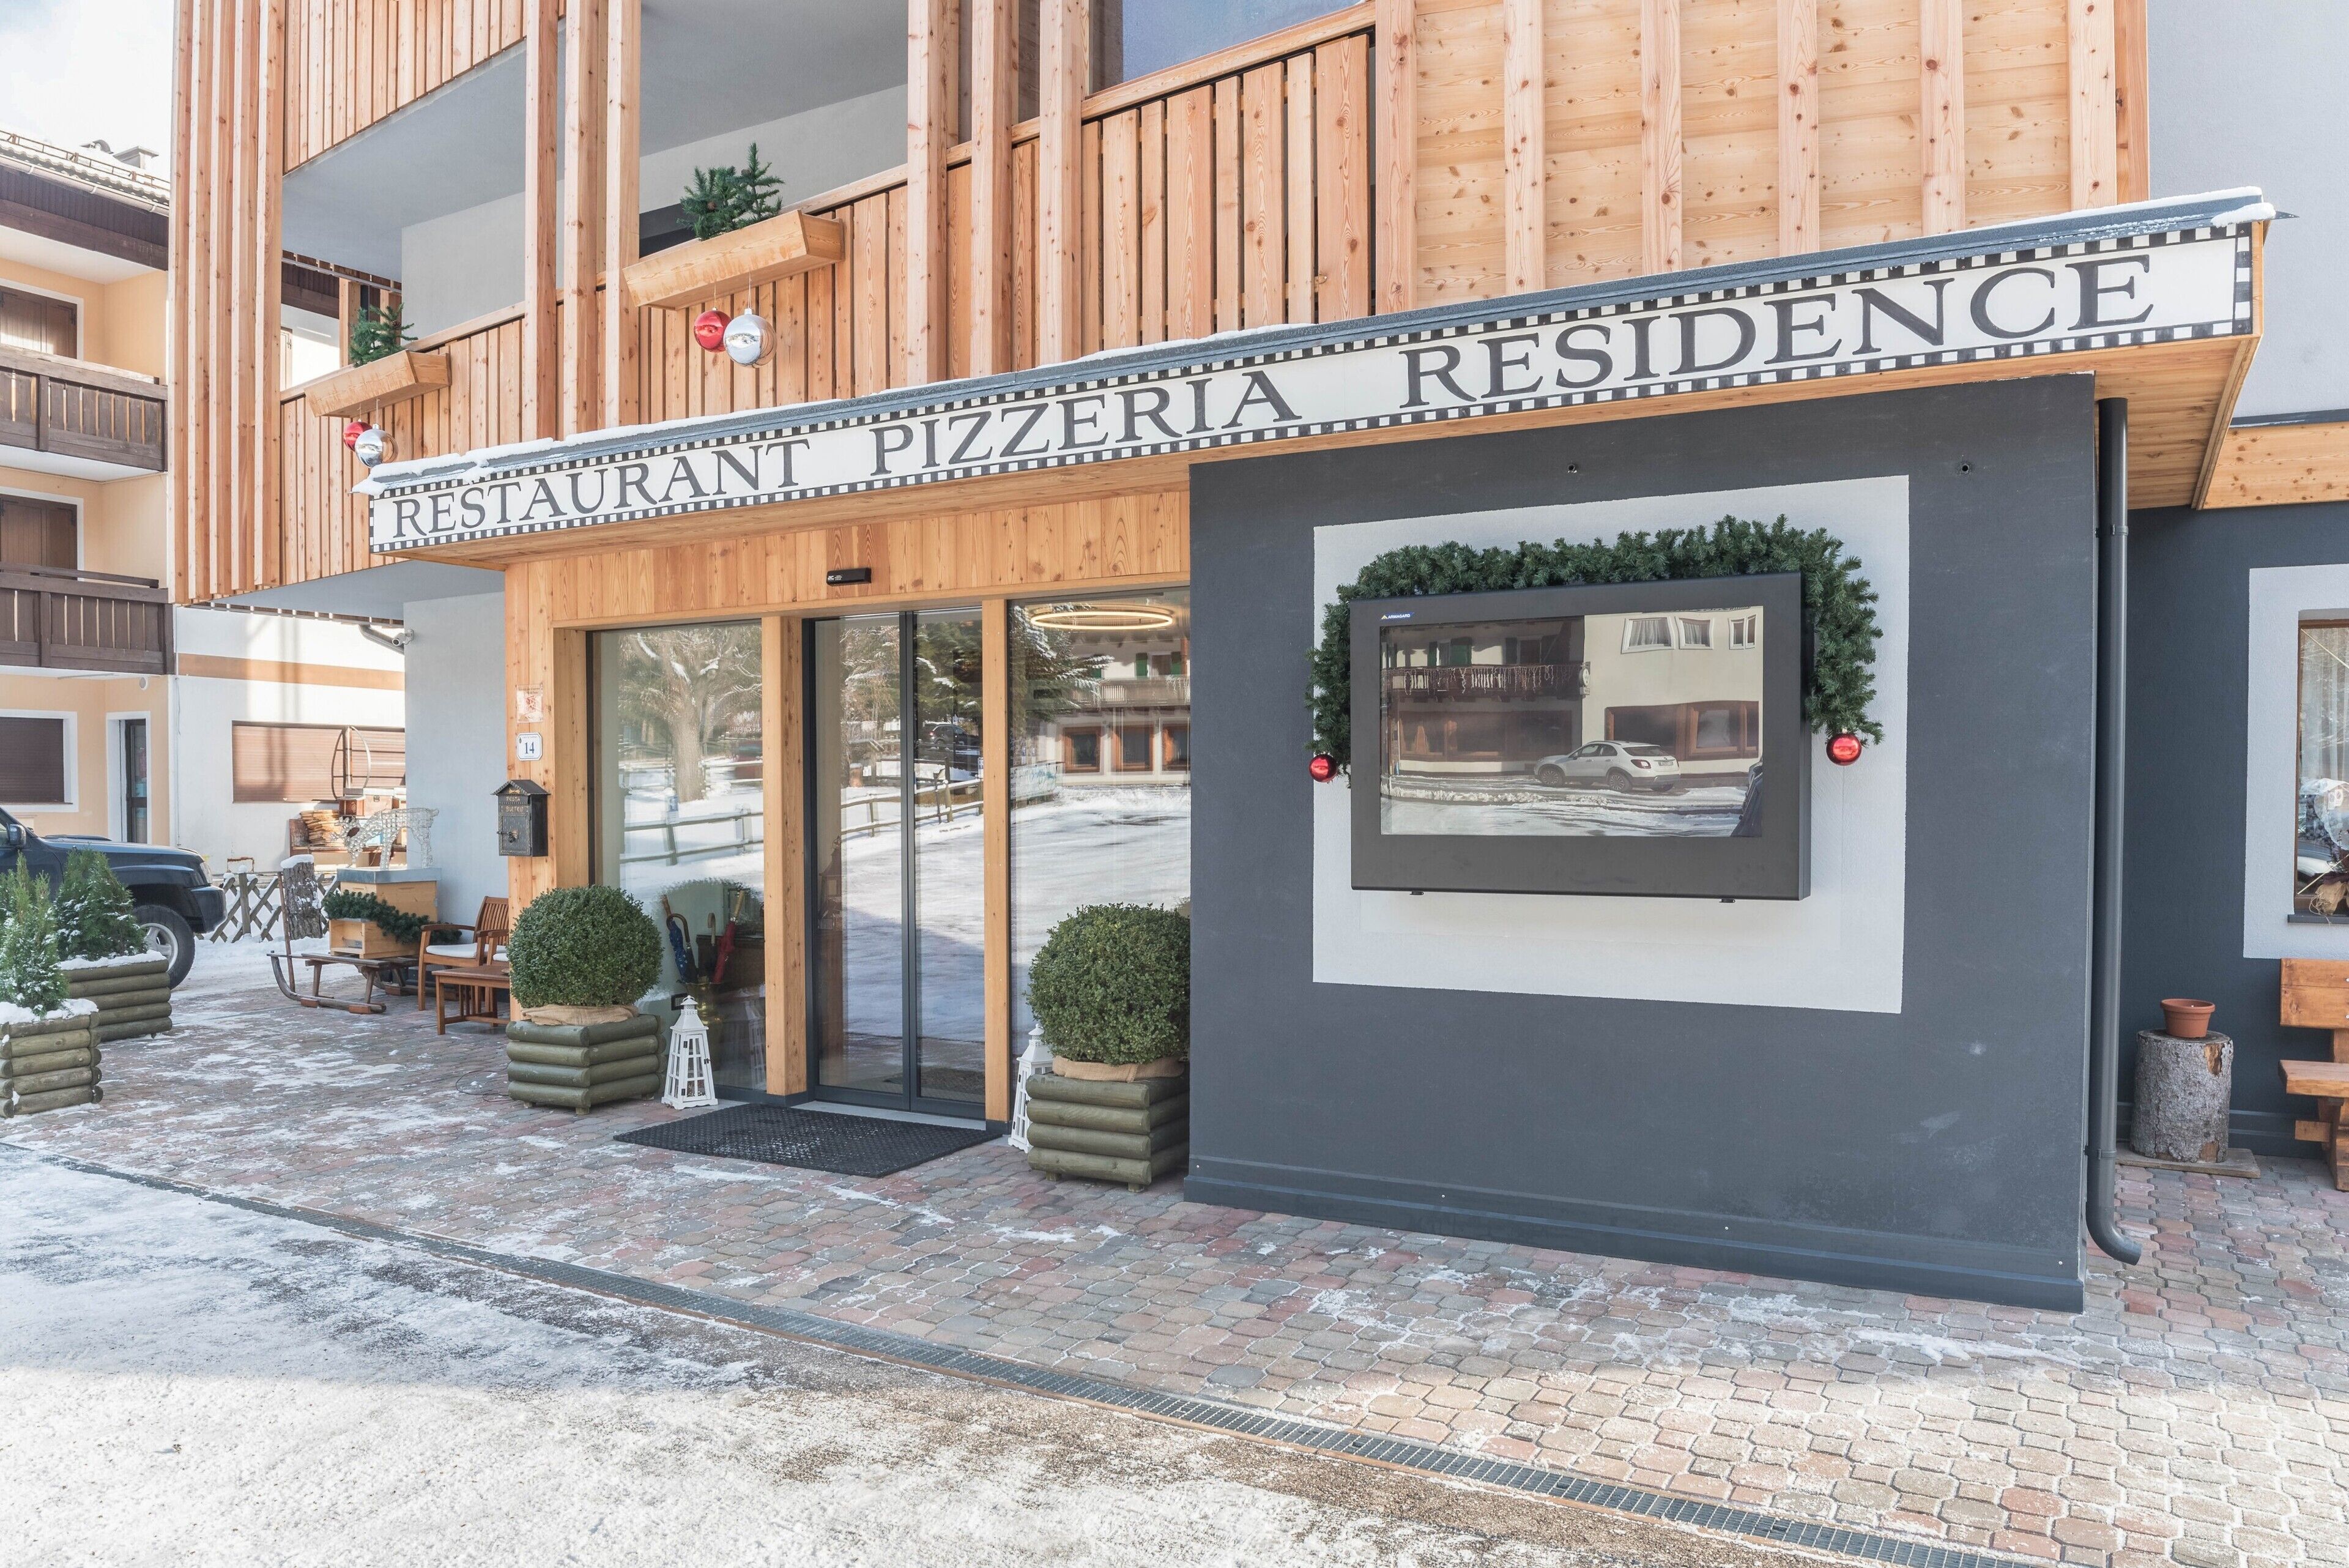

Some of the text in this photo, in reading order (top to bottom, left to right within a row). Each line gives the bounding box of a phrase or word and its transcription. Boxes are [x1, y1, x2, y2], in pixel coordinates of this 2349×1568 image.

[392, 254, 2154, 538] RESTAURANT PIZZERIA RESIDENCE
[525, 741, 535, 754] 14
